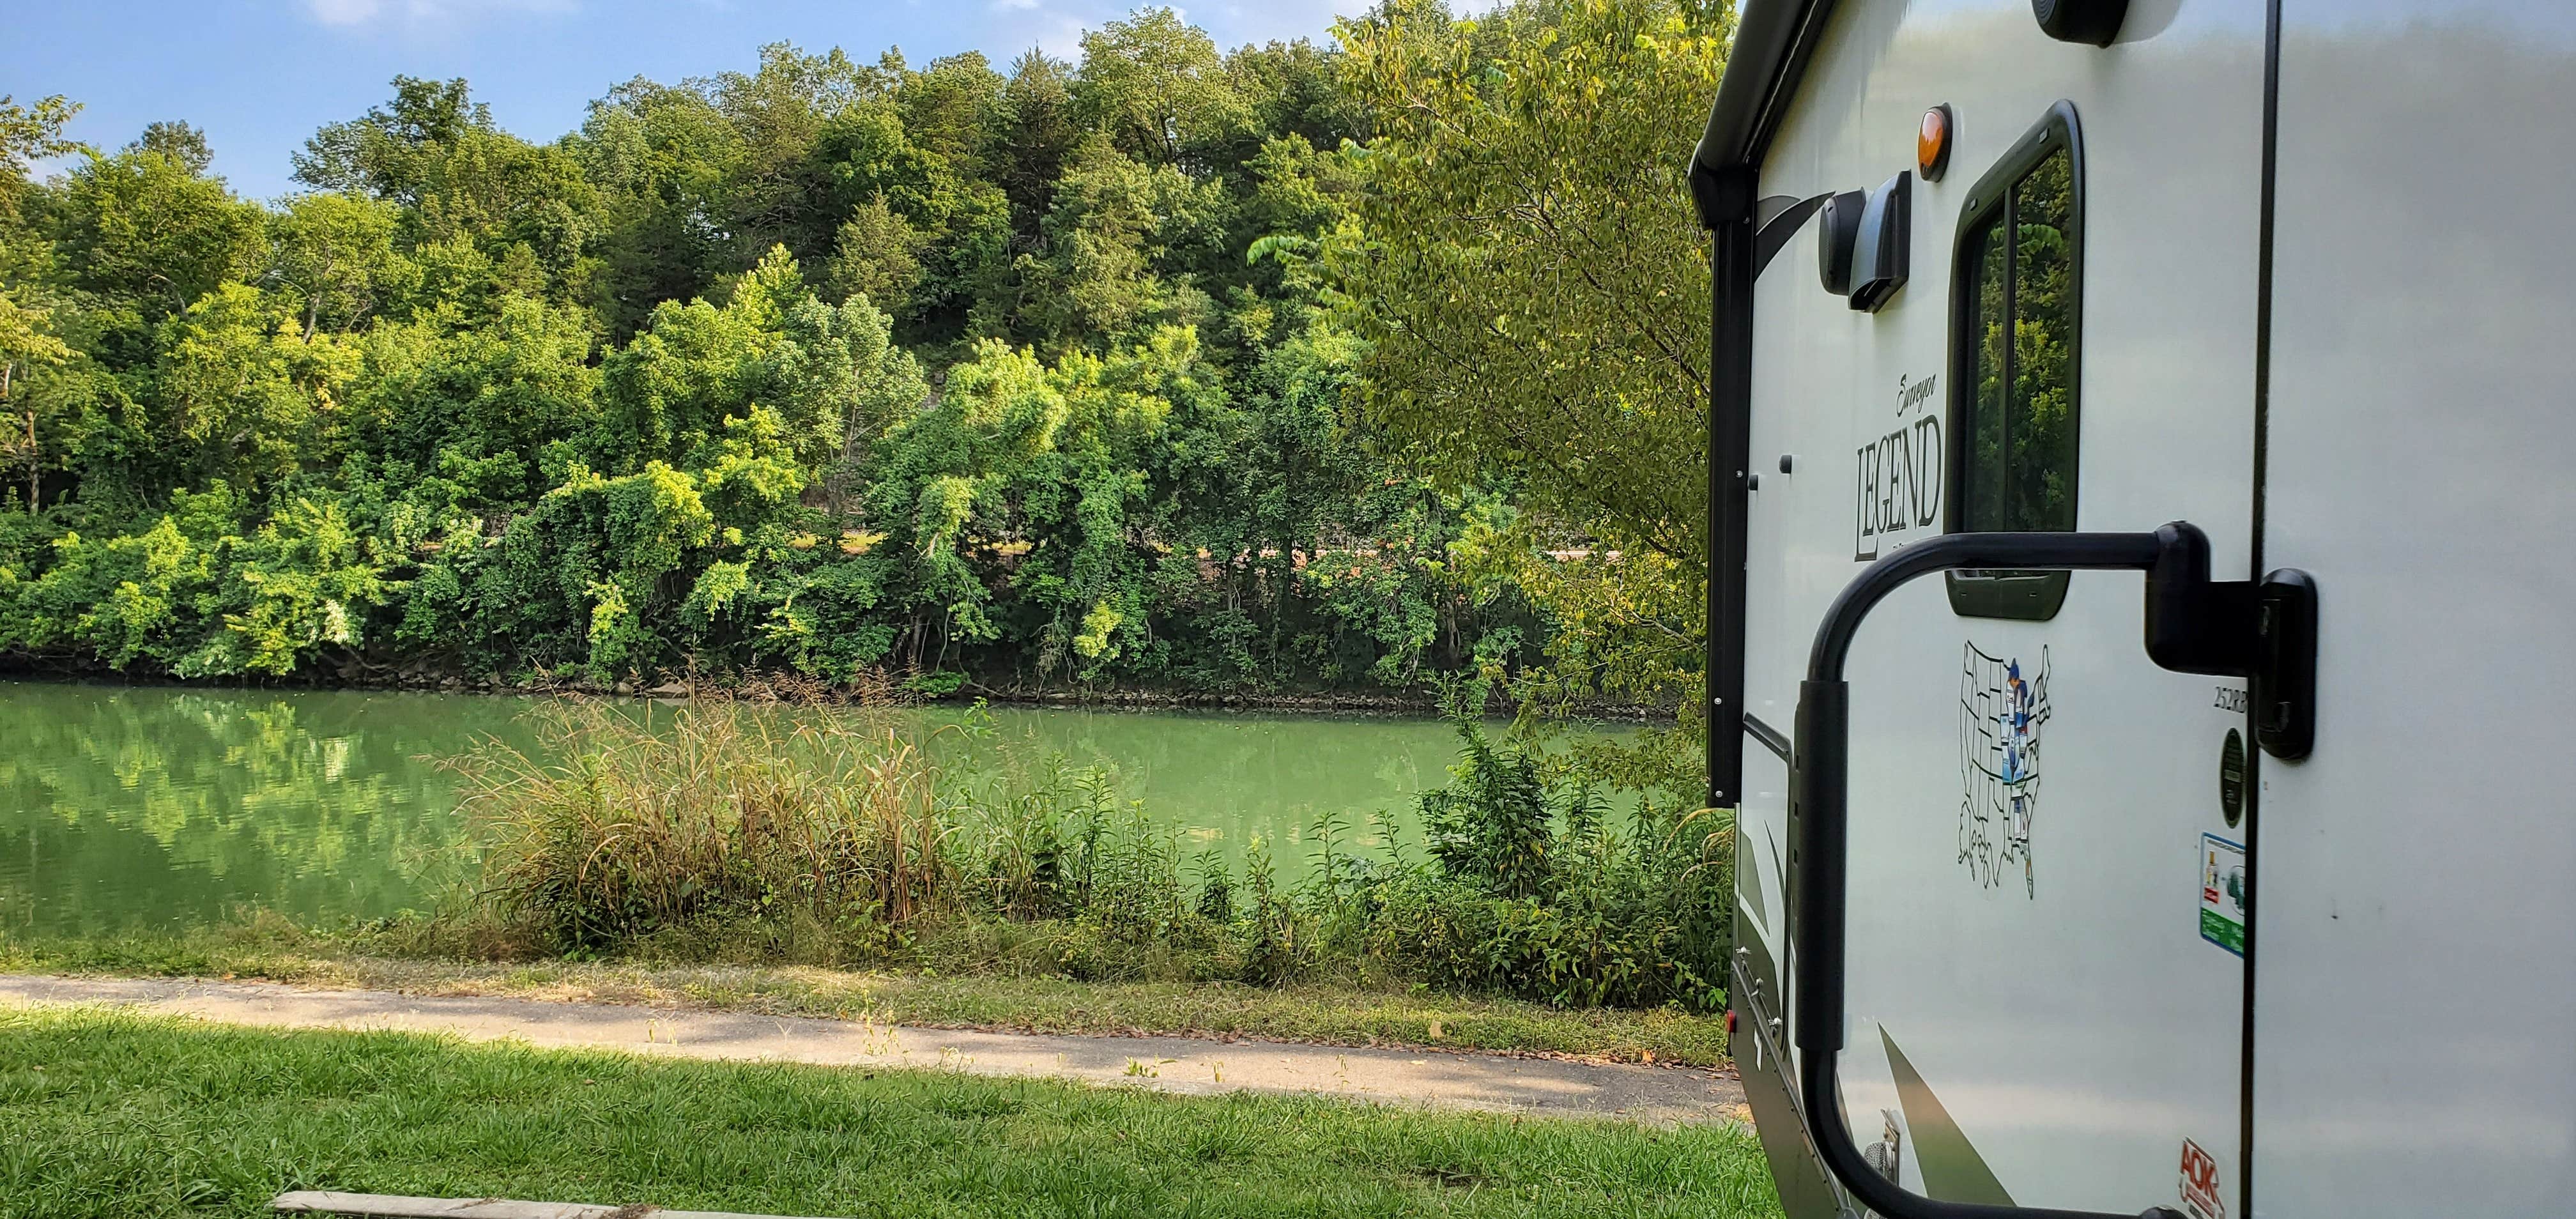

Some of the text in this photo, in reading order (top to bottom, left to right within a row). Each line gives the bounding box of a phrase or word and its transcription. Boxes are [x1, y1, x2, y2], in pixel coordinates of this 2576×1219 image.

[1896, 373, 1936, 417] Surveyor
[1854, 415, 1942, 562] LEGEND
[2181, 1142, 2216, 1204] AOK
